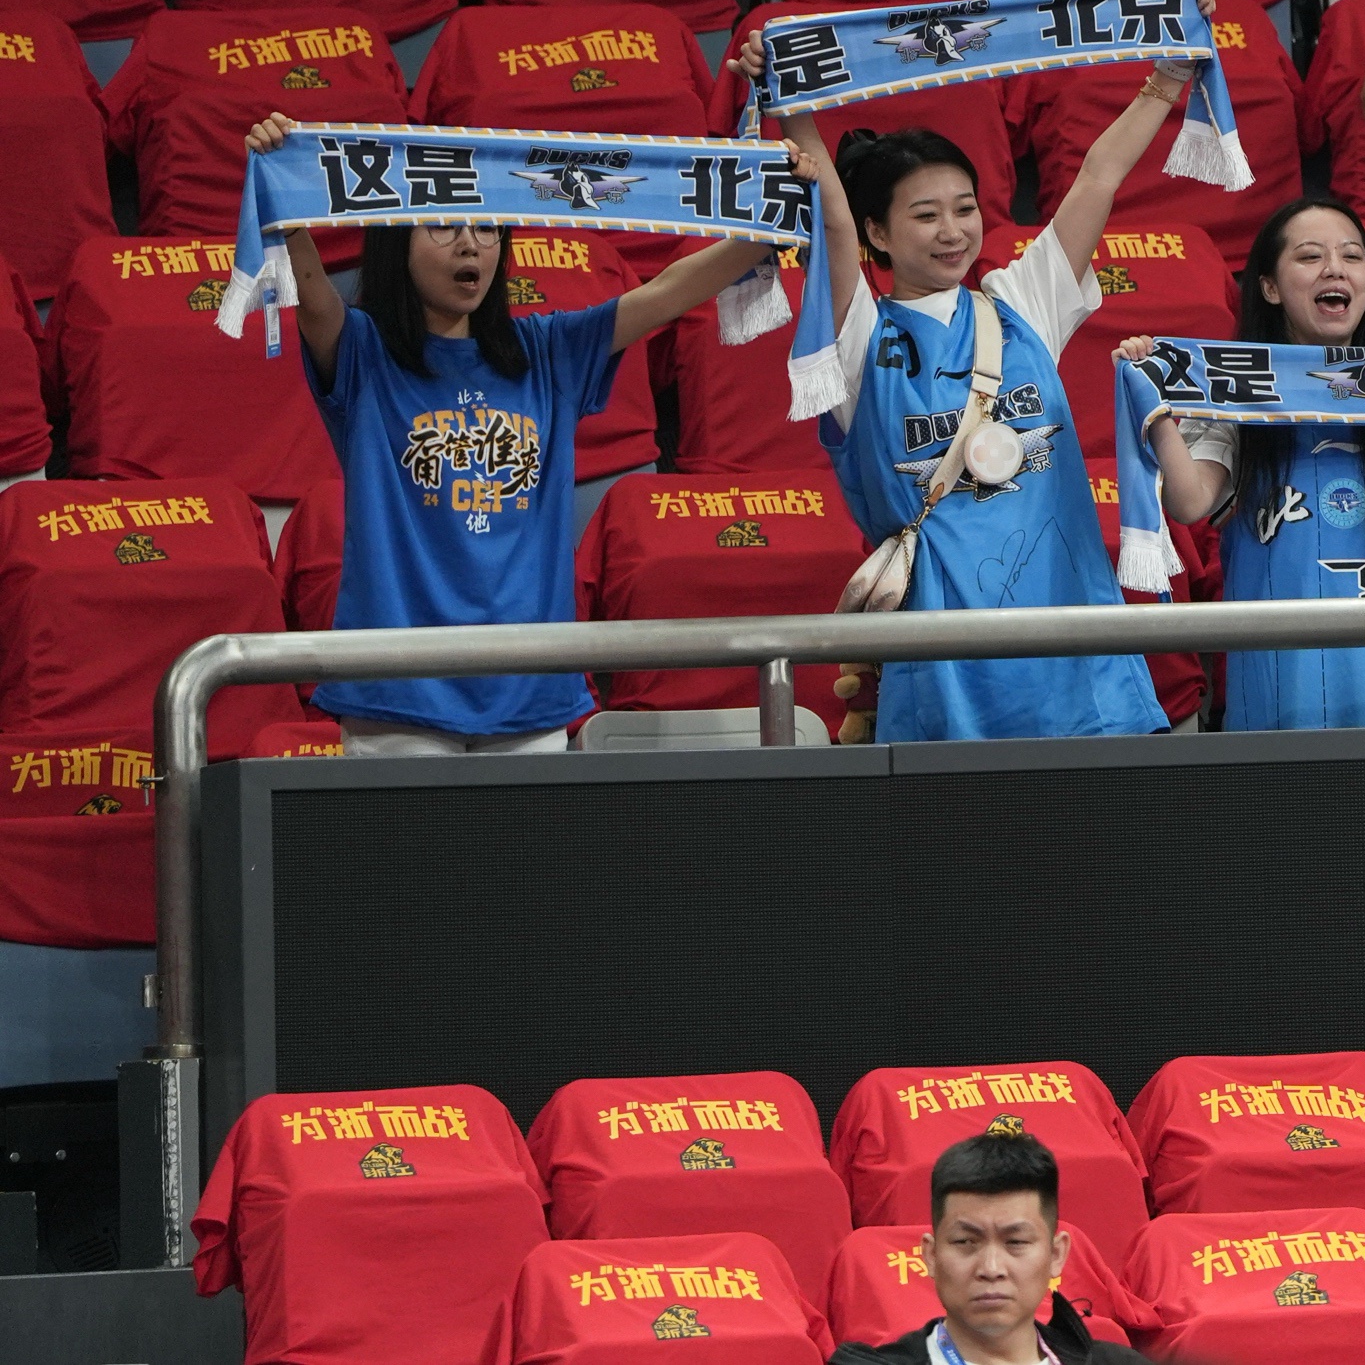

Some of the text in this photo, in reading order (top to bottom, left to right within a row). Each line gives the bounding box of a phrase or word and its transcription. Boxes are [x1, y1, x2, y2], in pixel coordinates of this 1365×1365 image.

[761, 24, 853, 102] 是
[318, 135, 813, 233] 这是 北京
[525, 145, 633, 170] DUCKS
[1131, 339, 1282, 407] 这是
[904, 382, 1045, 454] DUKS
[465, 508, 491, 534] 他
[516, 496, 530, 510] 25
